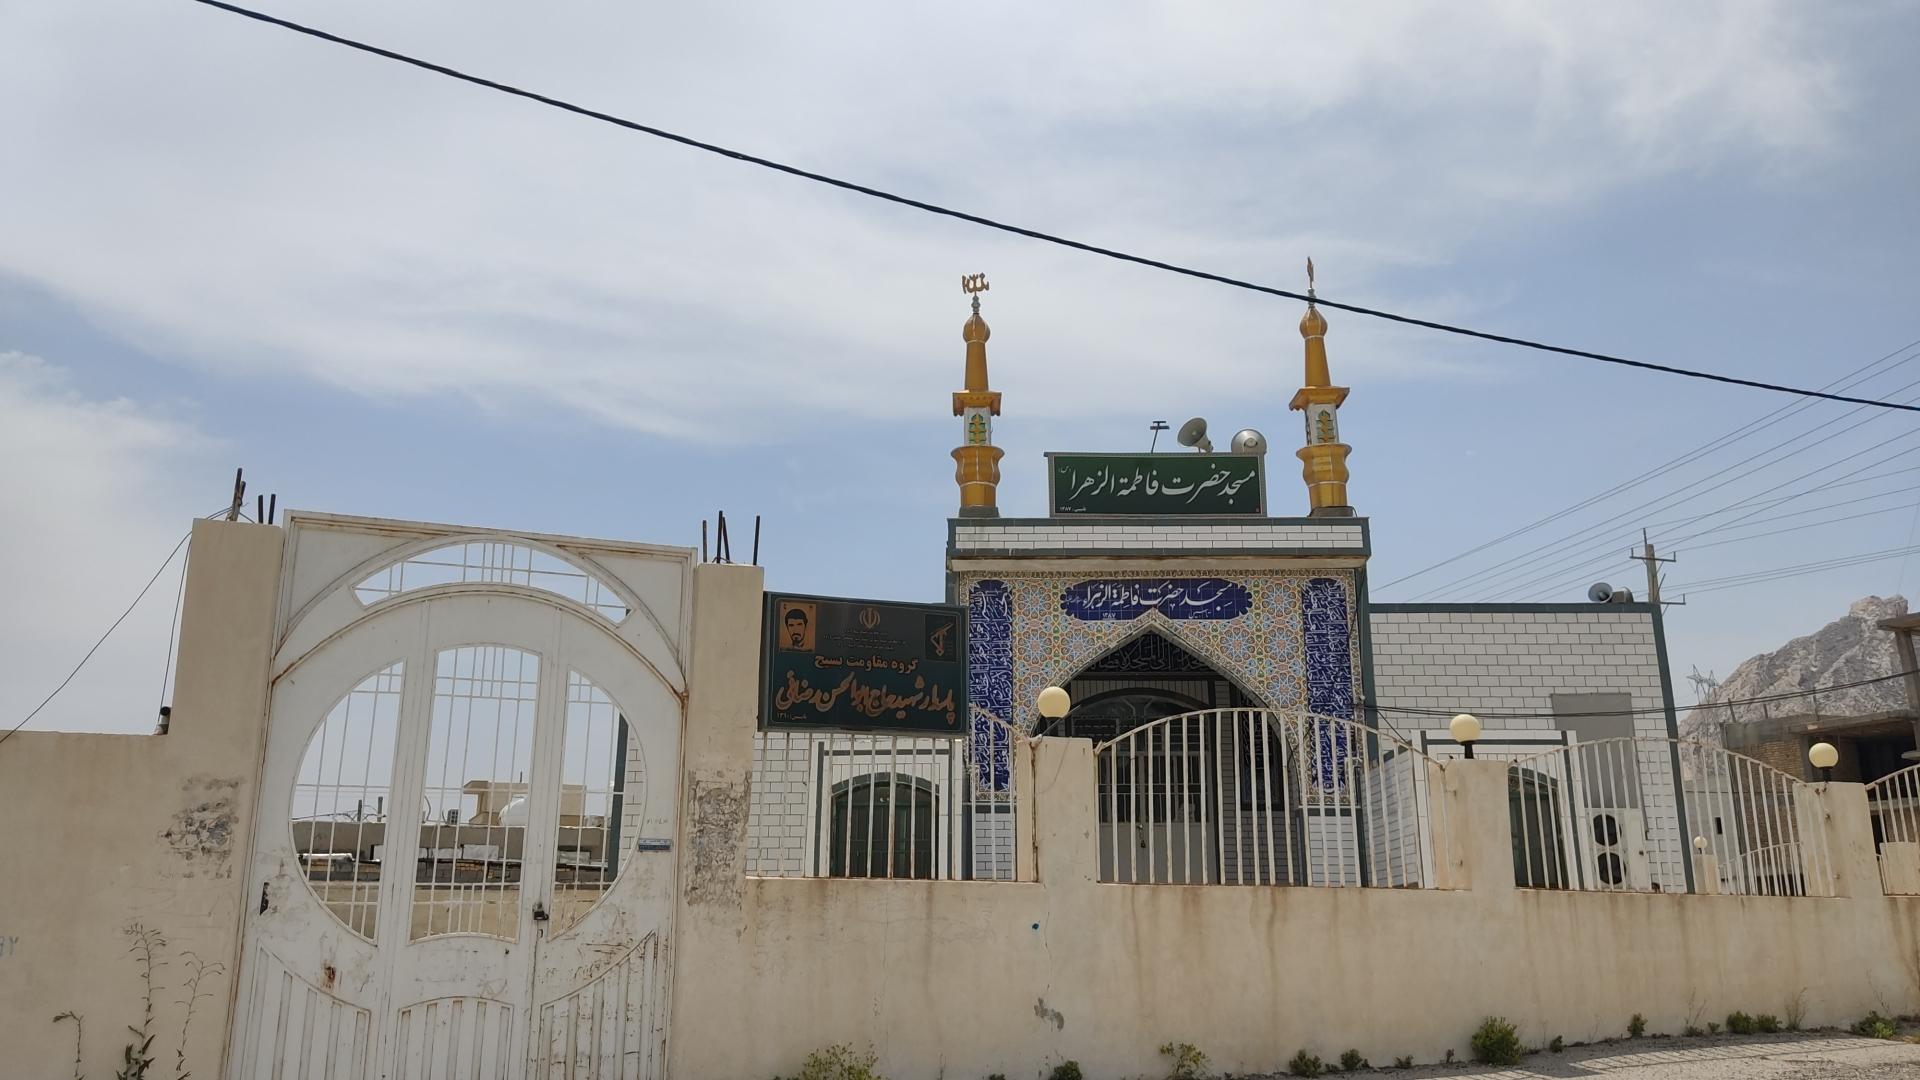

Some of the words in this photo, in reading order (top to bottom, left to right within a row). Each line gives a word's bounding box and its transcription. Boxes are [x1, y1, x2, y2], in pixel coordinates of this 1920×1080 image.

[1161, 463, 1231, 504] حضرت
[1216, 469, 1256, 505] مسجد
[814, 655, 843, 669] بسیج
[845, 655, 889, 672] مقاومت
[890, 657, 918, 675] گروه
